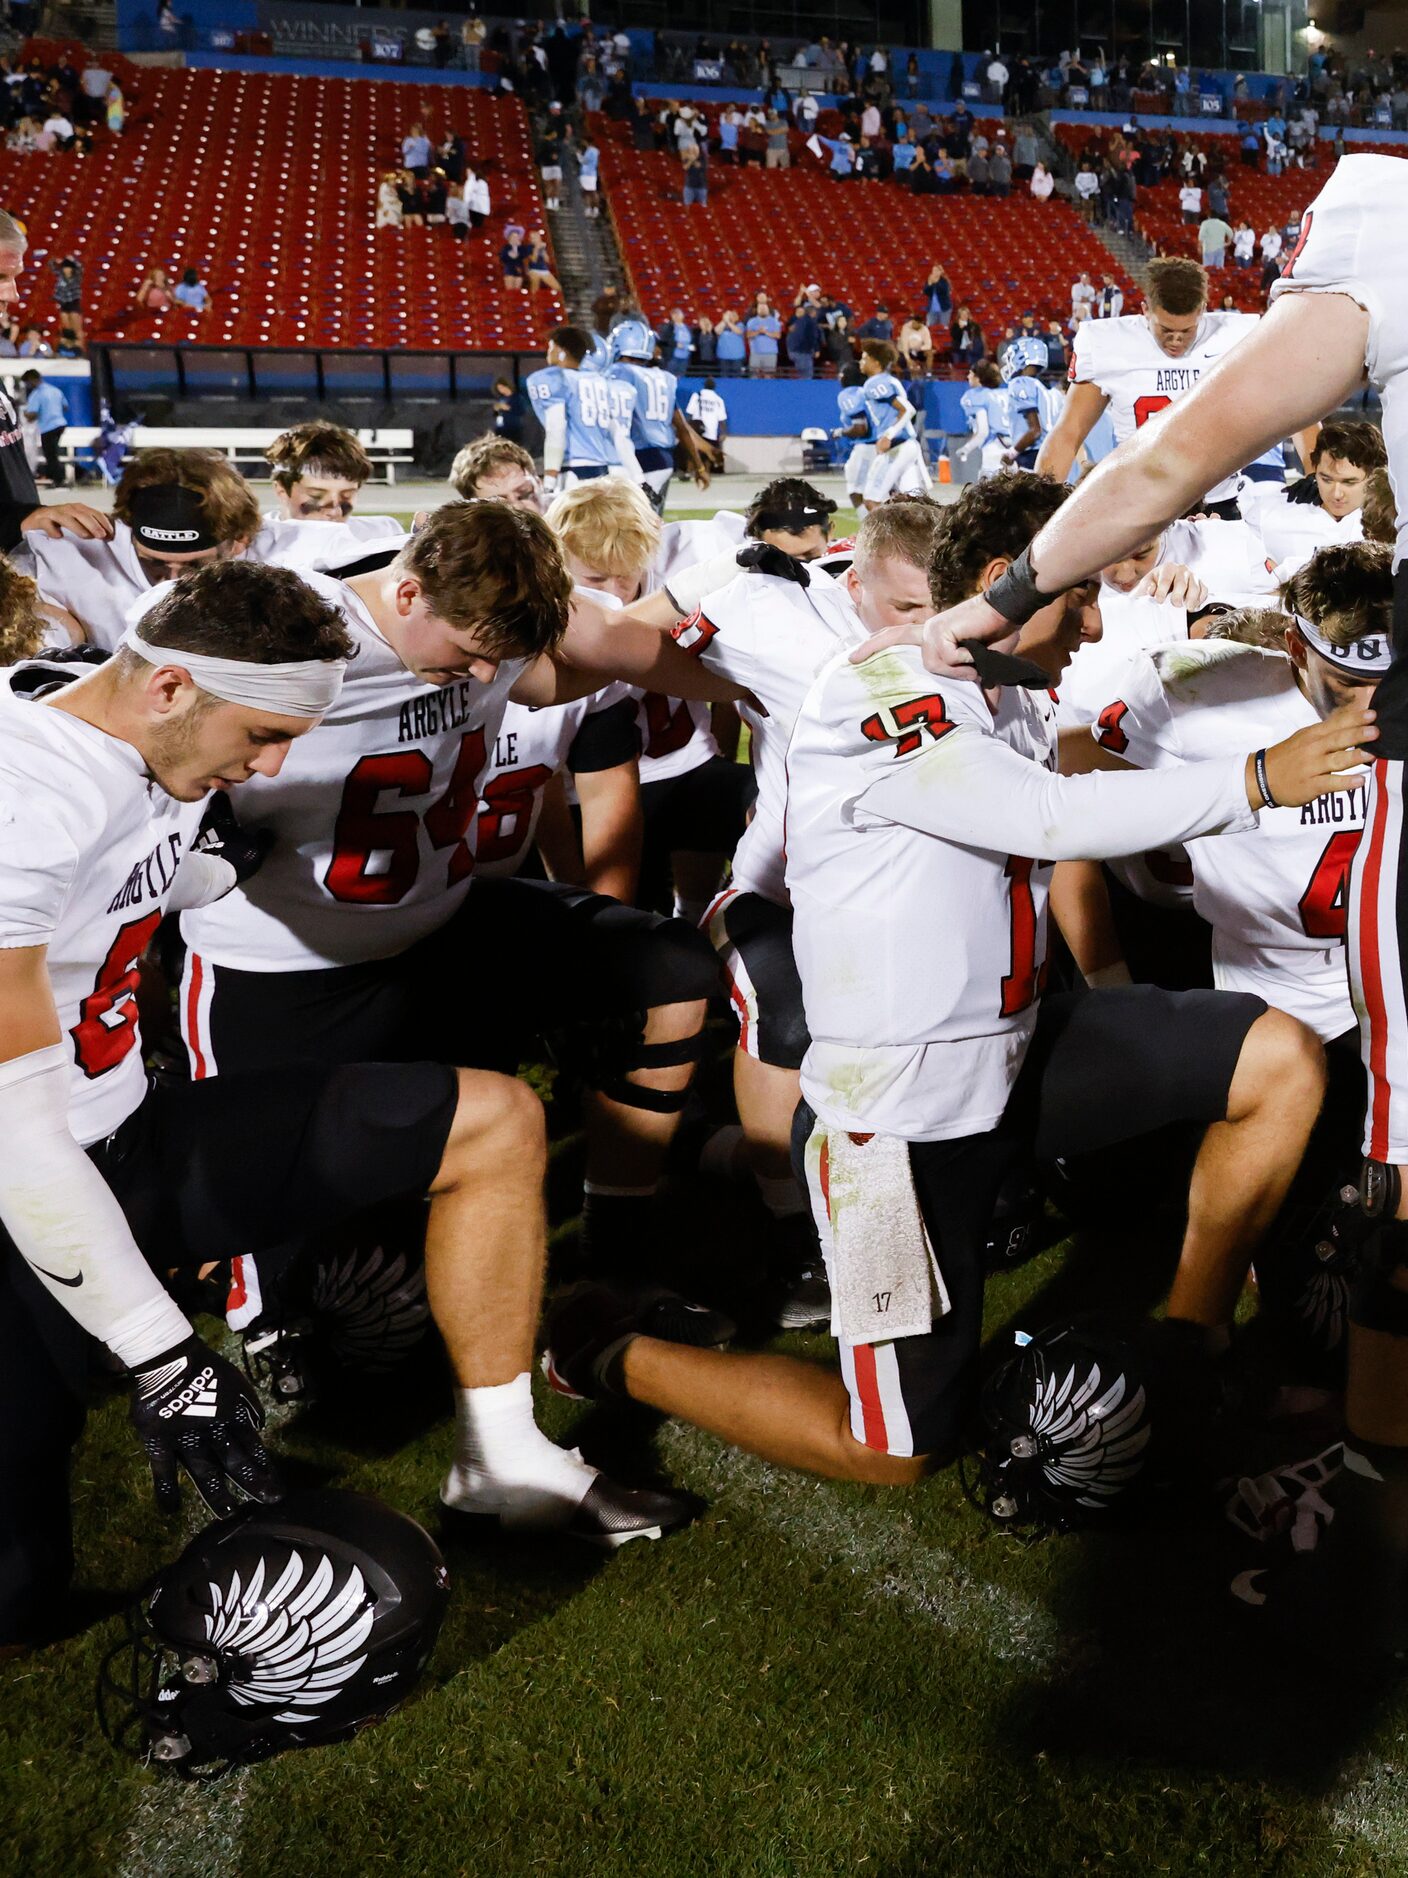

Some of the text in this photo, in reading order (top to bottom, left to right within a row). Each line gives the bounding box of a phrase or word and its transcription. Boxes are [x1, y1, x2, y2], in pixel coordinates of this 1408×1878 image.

[1202, 98, 1220, 112] 105
[645, 375, 669, 422] 16
[143, 527, 198, 542] BATTLE
[398, 681, 471, 743] ARGYLE
[322, 724, 488, 906] 64
[871, 1291, 893, 1313] 17
[158, 1366, 214, 1419] adidas
